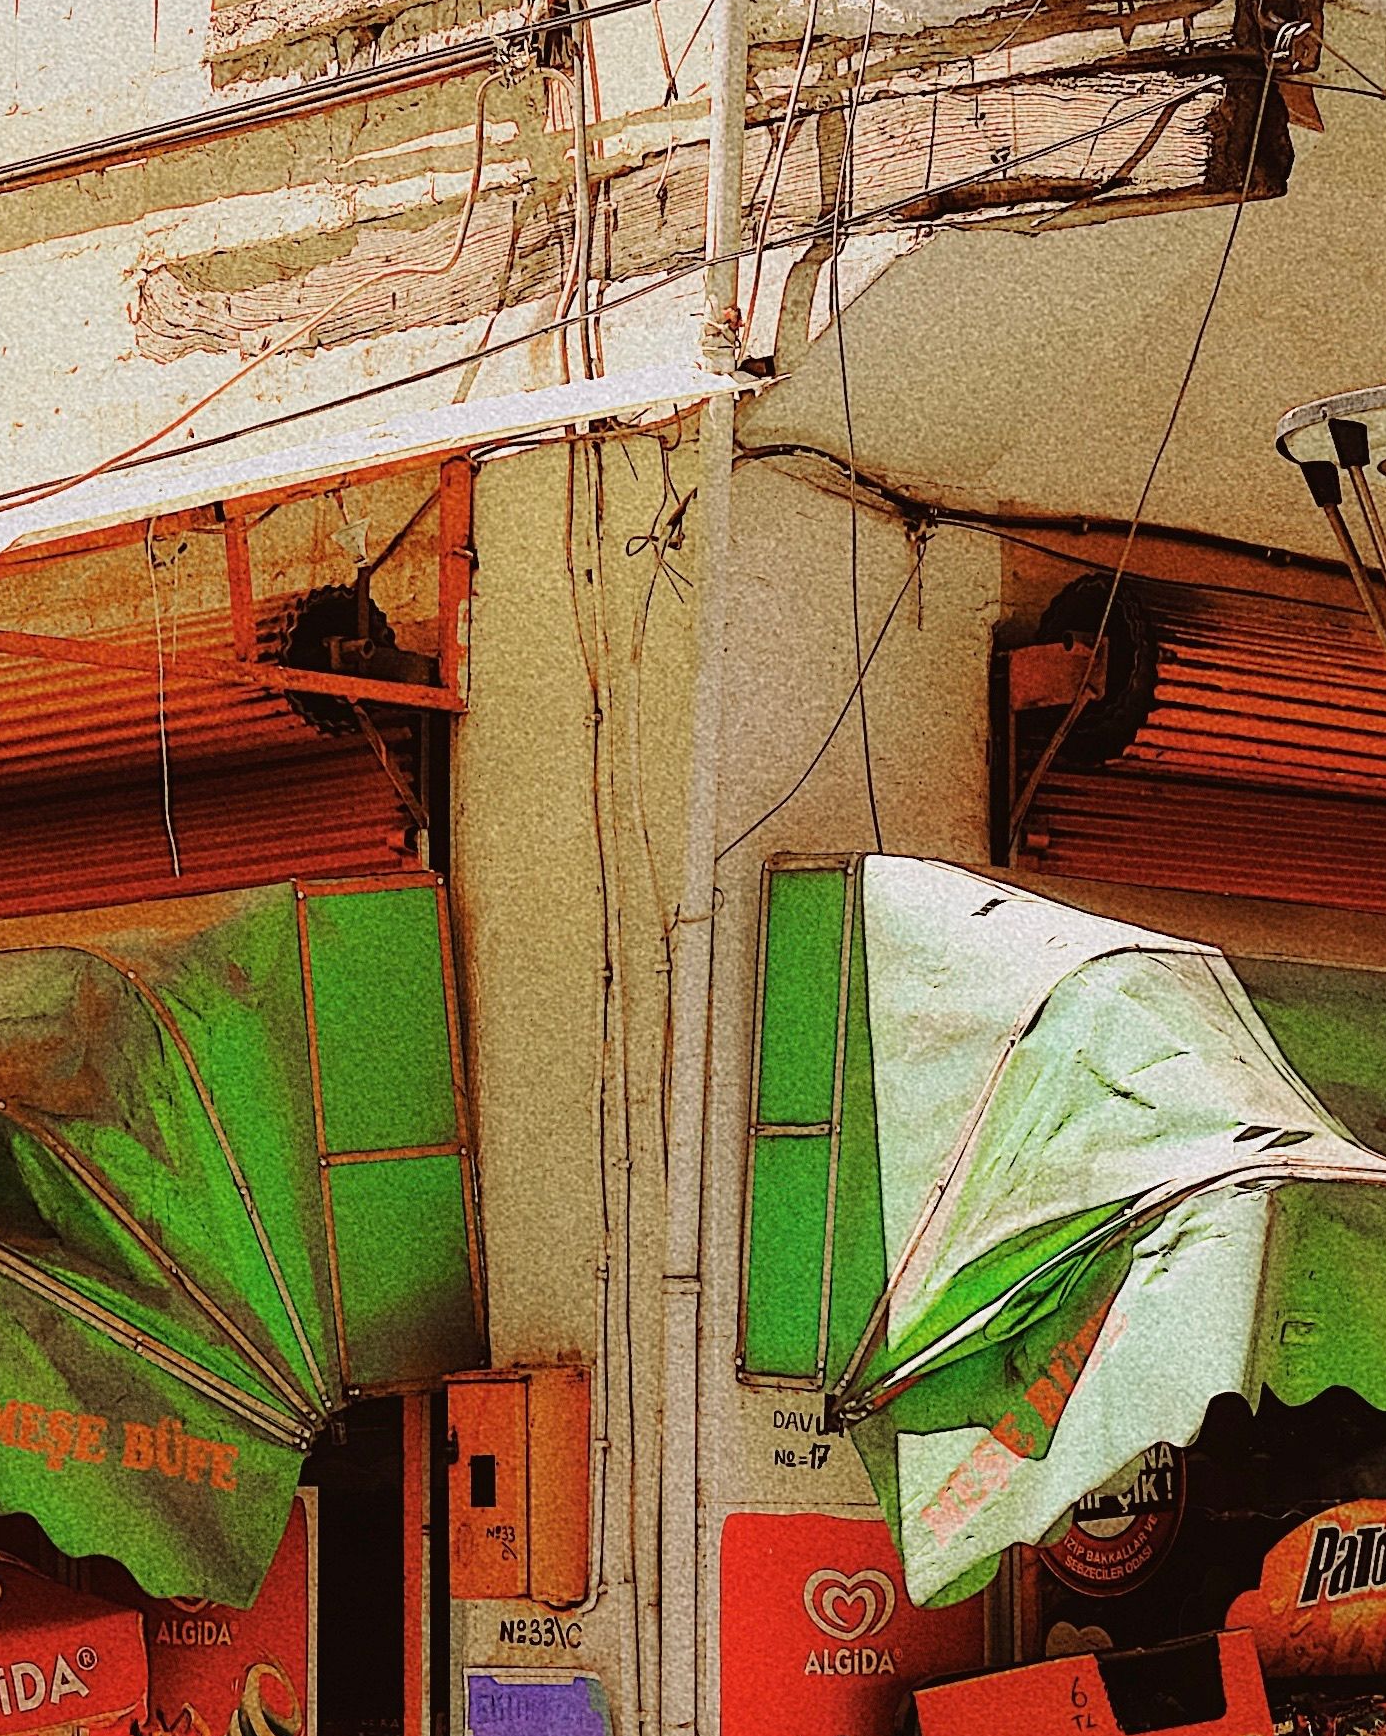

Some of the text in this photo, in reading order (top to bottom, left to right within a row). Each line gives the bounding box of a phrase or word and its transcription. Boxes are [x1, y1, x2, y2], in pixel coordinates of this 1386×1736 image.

[121, 1416, 240, 1491] BÜFE
[1086, 1530, 1149, 1564] BAKKALLAR
[1071, 1676, 1088, 1709] 6
